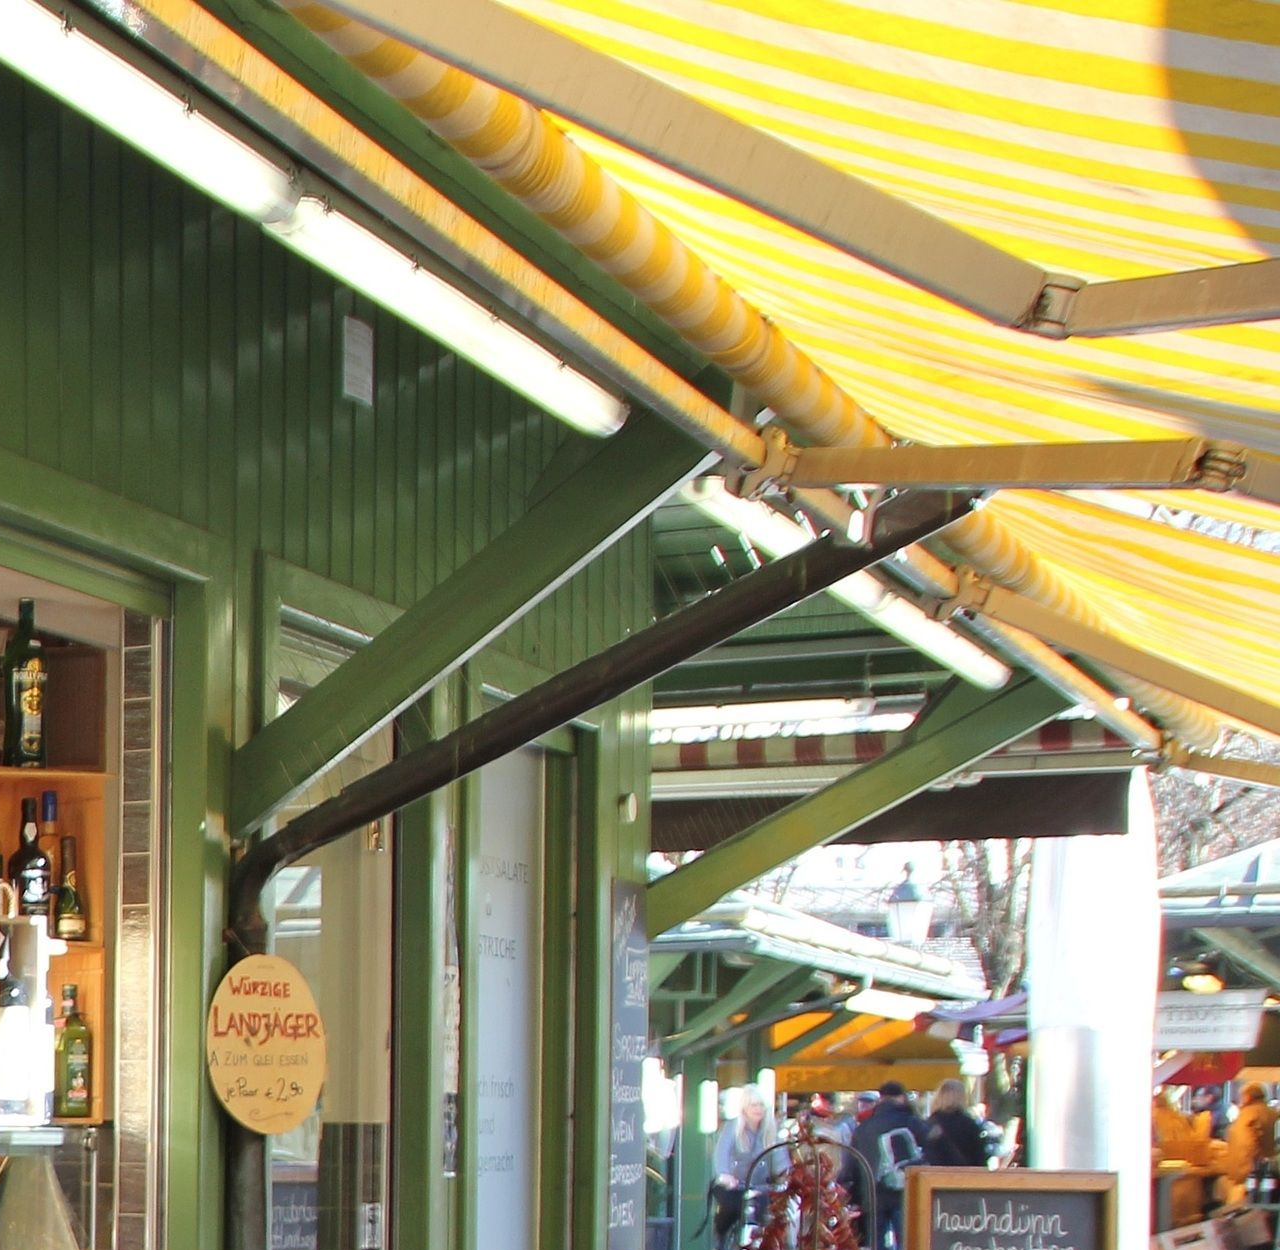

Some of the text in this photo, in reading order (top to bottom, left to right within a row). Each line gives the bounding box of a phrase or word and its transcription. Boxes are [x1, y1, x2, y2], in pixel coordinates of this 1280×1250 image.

[228, 975, 291, 998] WÜRZIGE
[213, 1005, 320, 1046] LANDJÄGER
[934, 1198, 1068, 1239] hauchdünn
